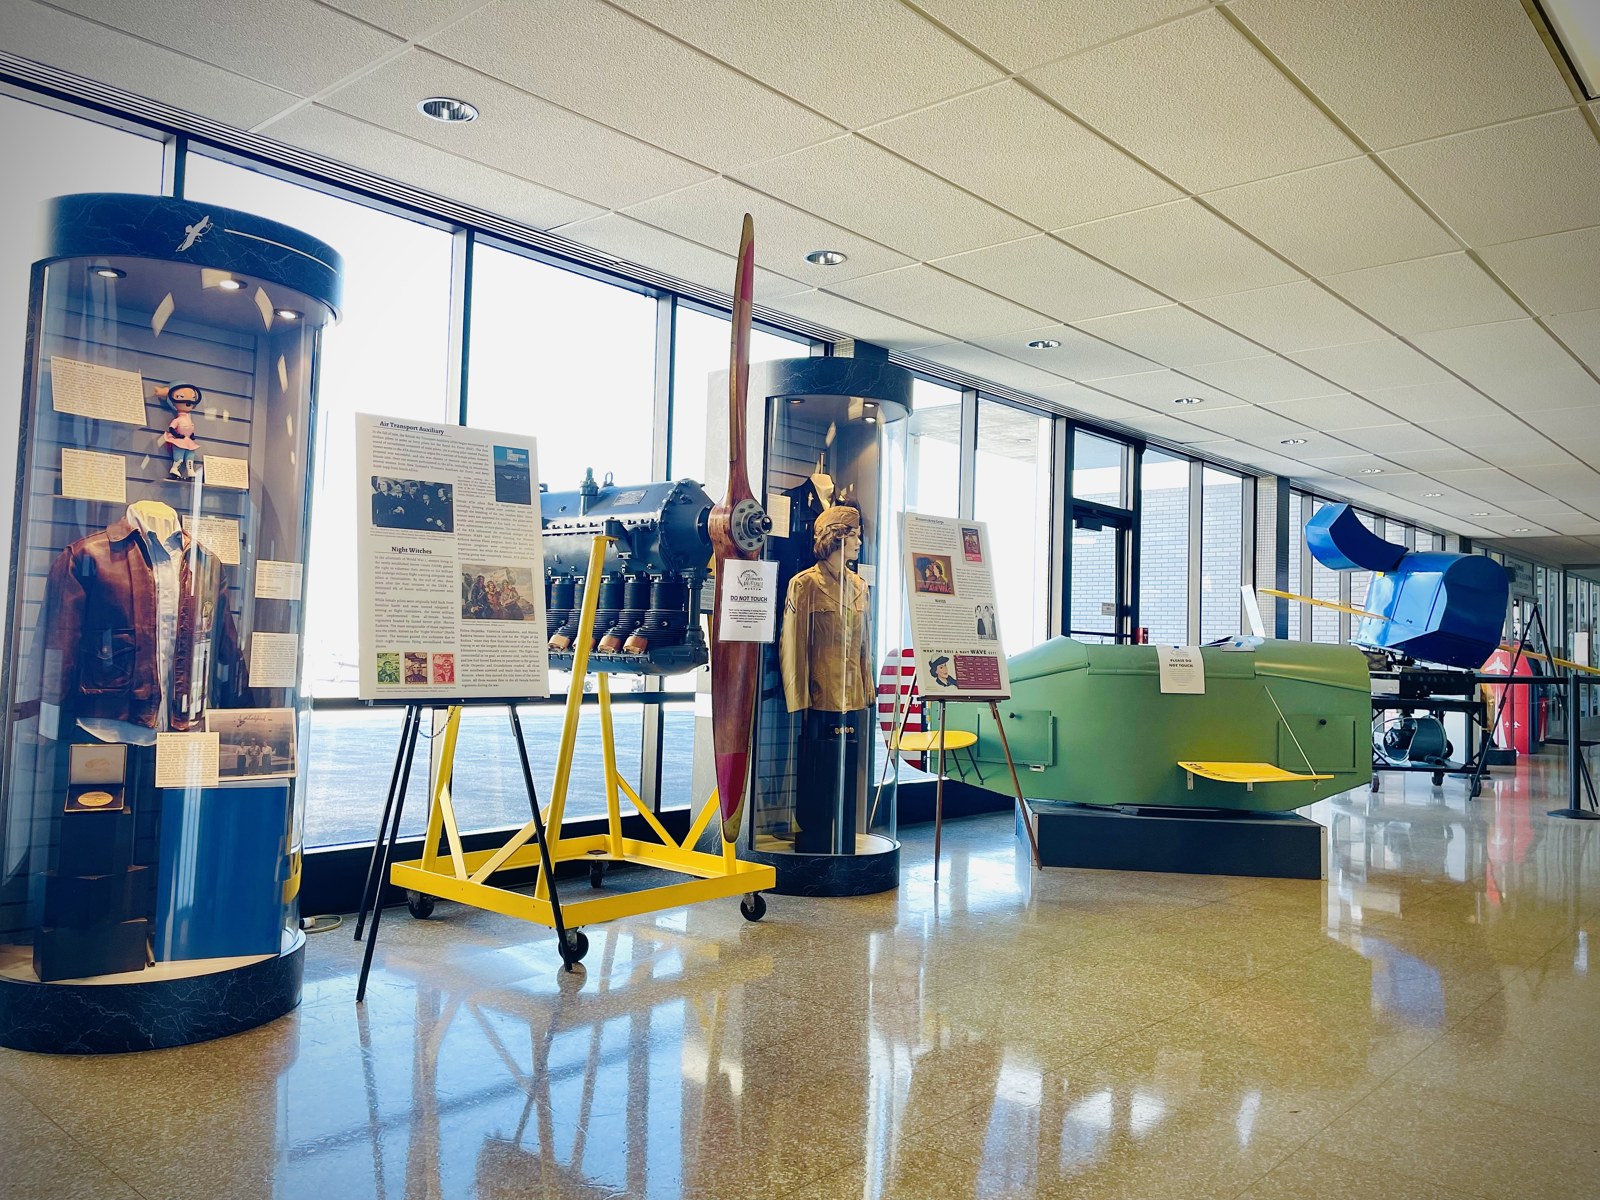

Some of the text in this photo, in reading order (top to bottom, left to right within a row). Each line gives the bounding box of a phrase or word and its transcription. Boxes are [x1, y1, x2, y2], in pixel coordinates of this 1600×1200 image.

[390, 422, 418, 431] Transport
[419, 426, 444, 435] Auxiliary
[391, 546, 408, 554] Night
